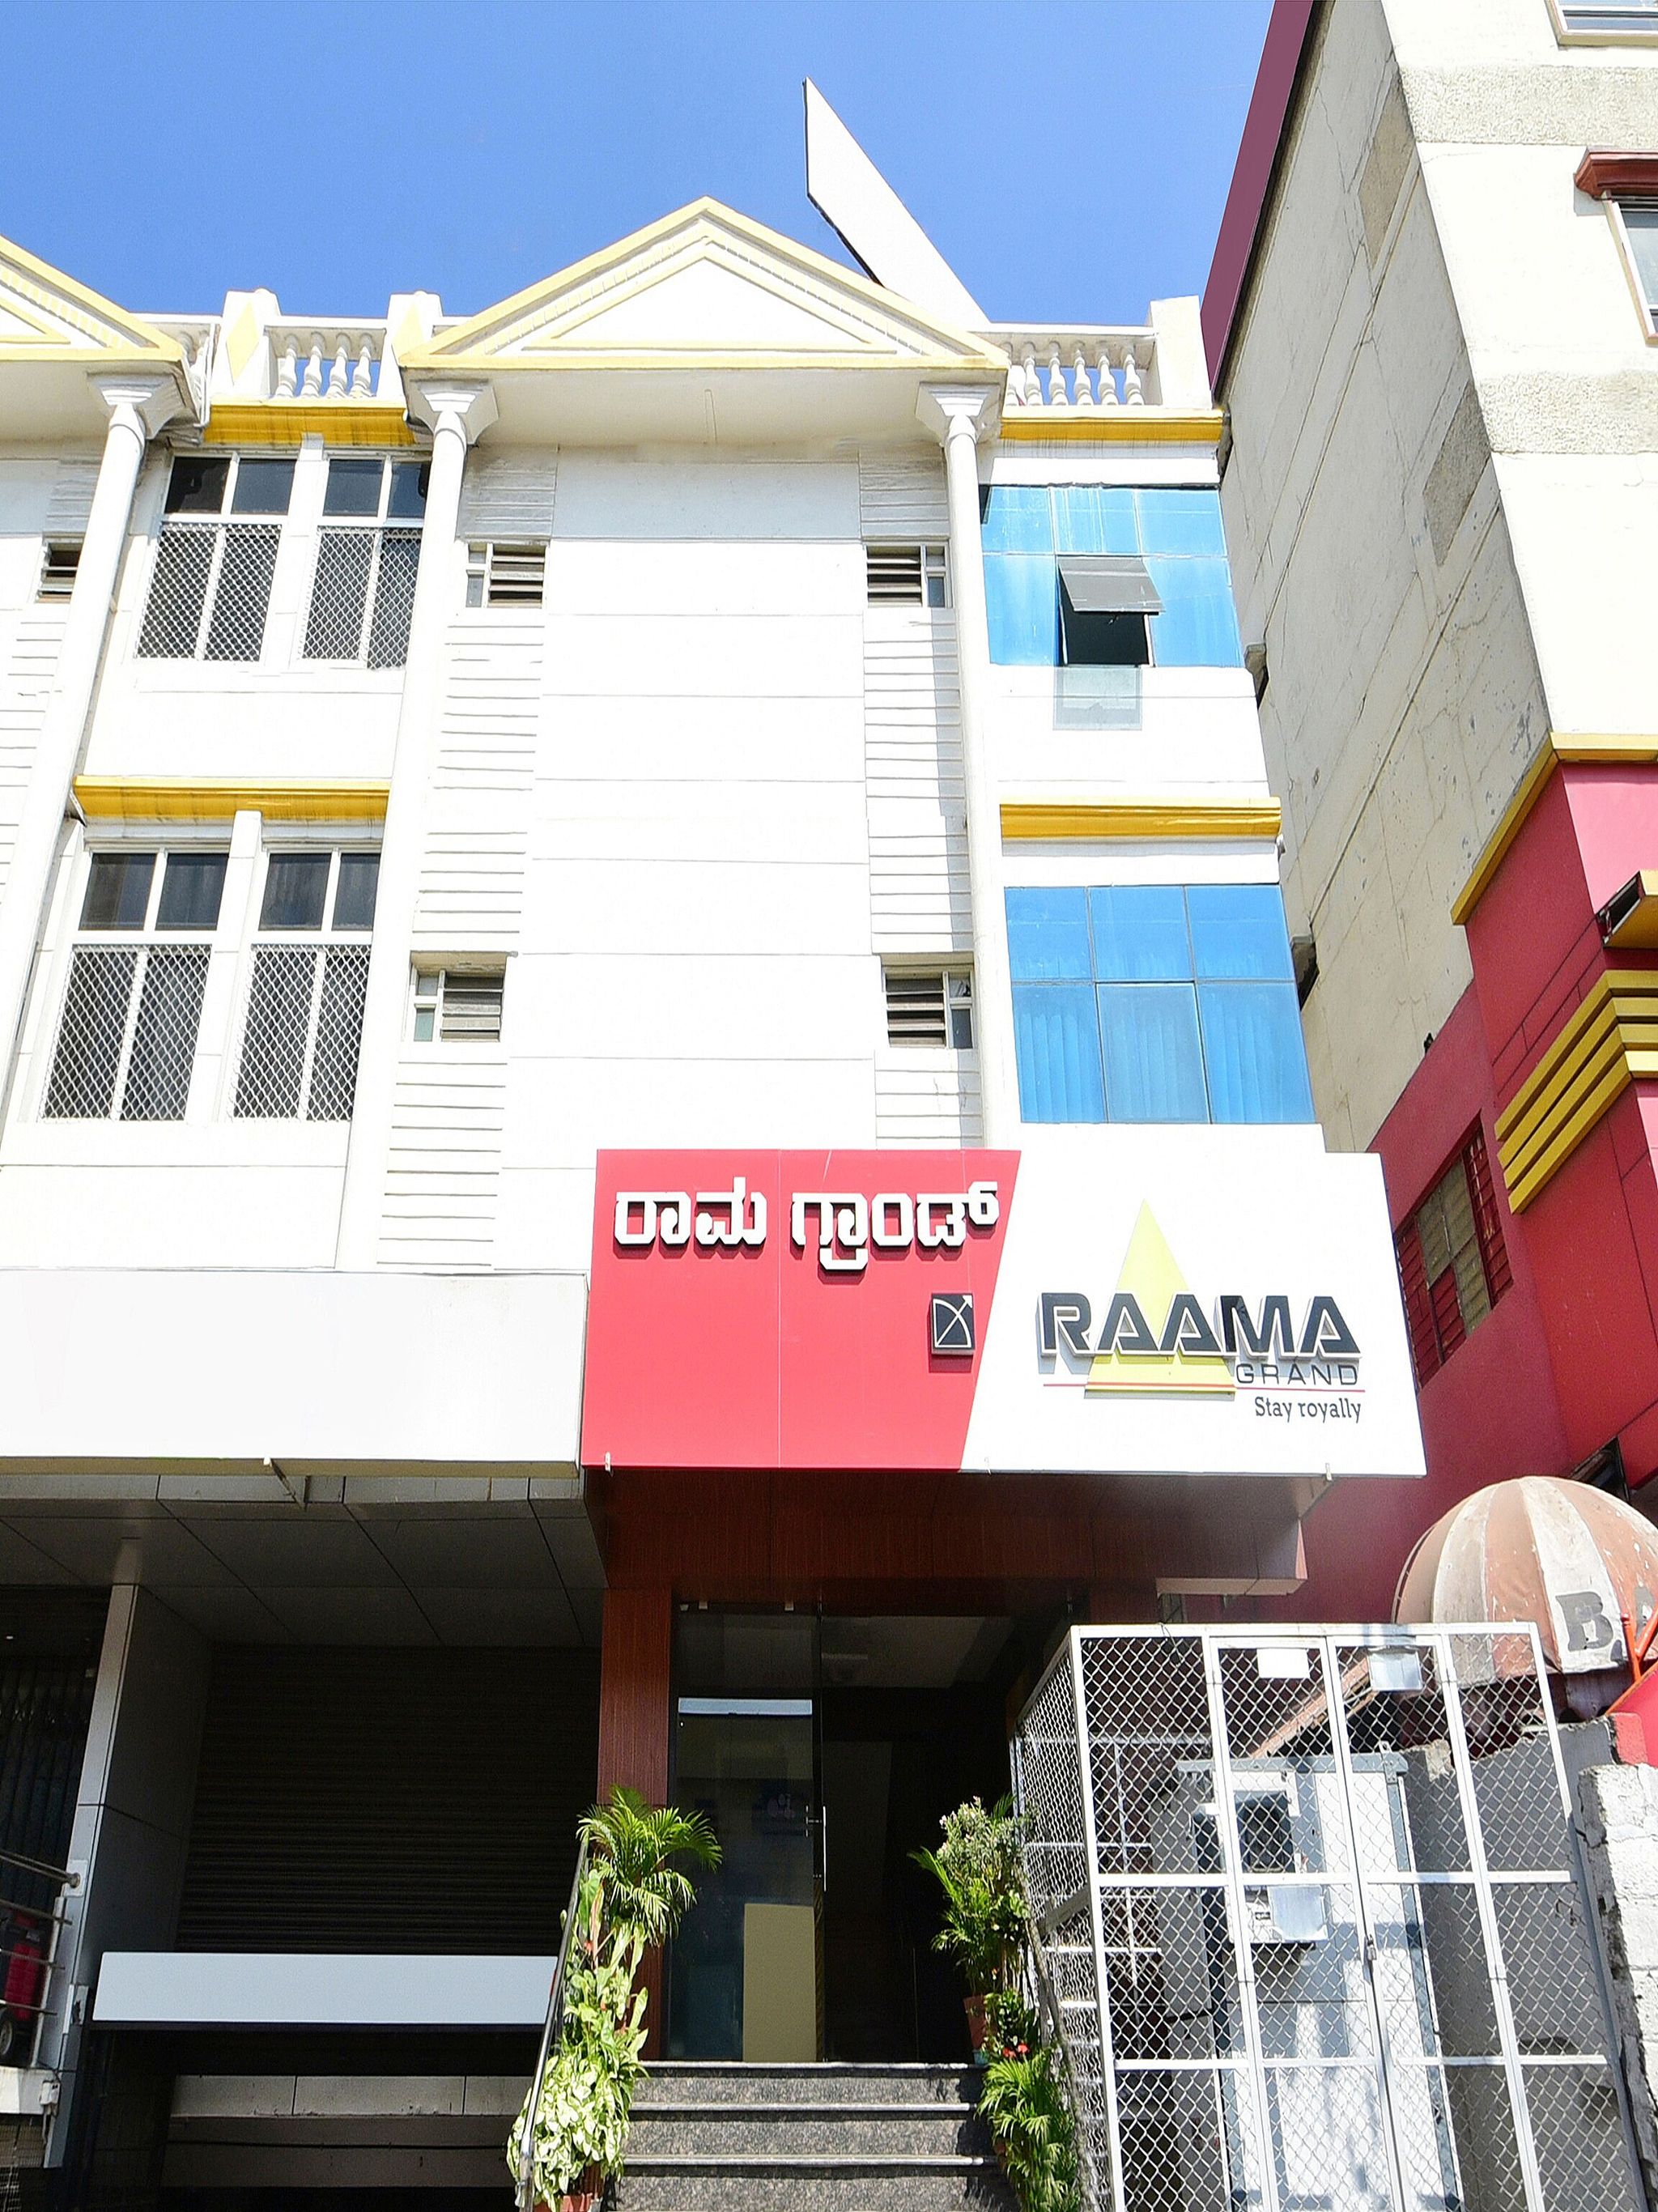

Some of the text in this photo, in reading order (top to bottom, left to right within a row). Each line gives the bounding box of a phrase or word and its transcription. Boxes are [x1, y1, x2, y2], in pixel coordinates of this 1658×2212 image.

[1039, 1292, 1362, 1359] RAAMA
[1236, 1363, 1358, 1385] GRAND
[1255, 1397, 1361, 1423] Stay royally
